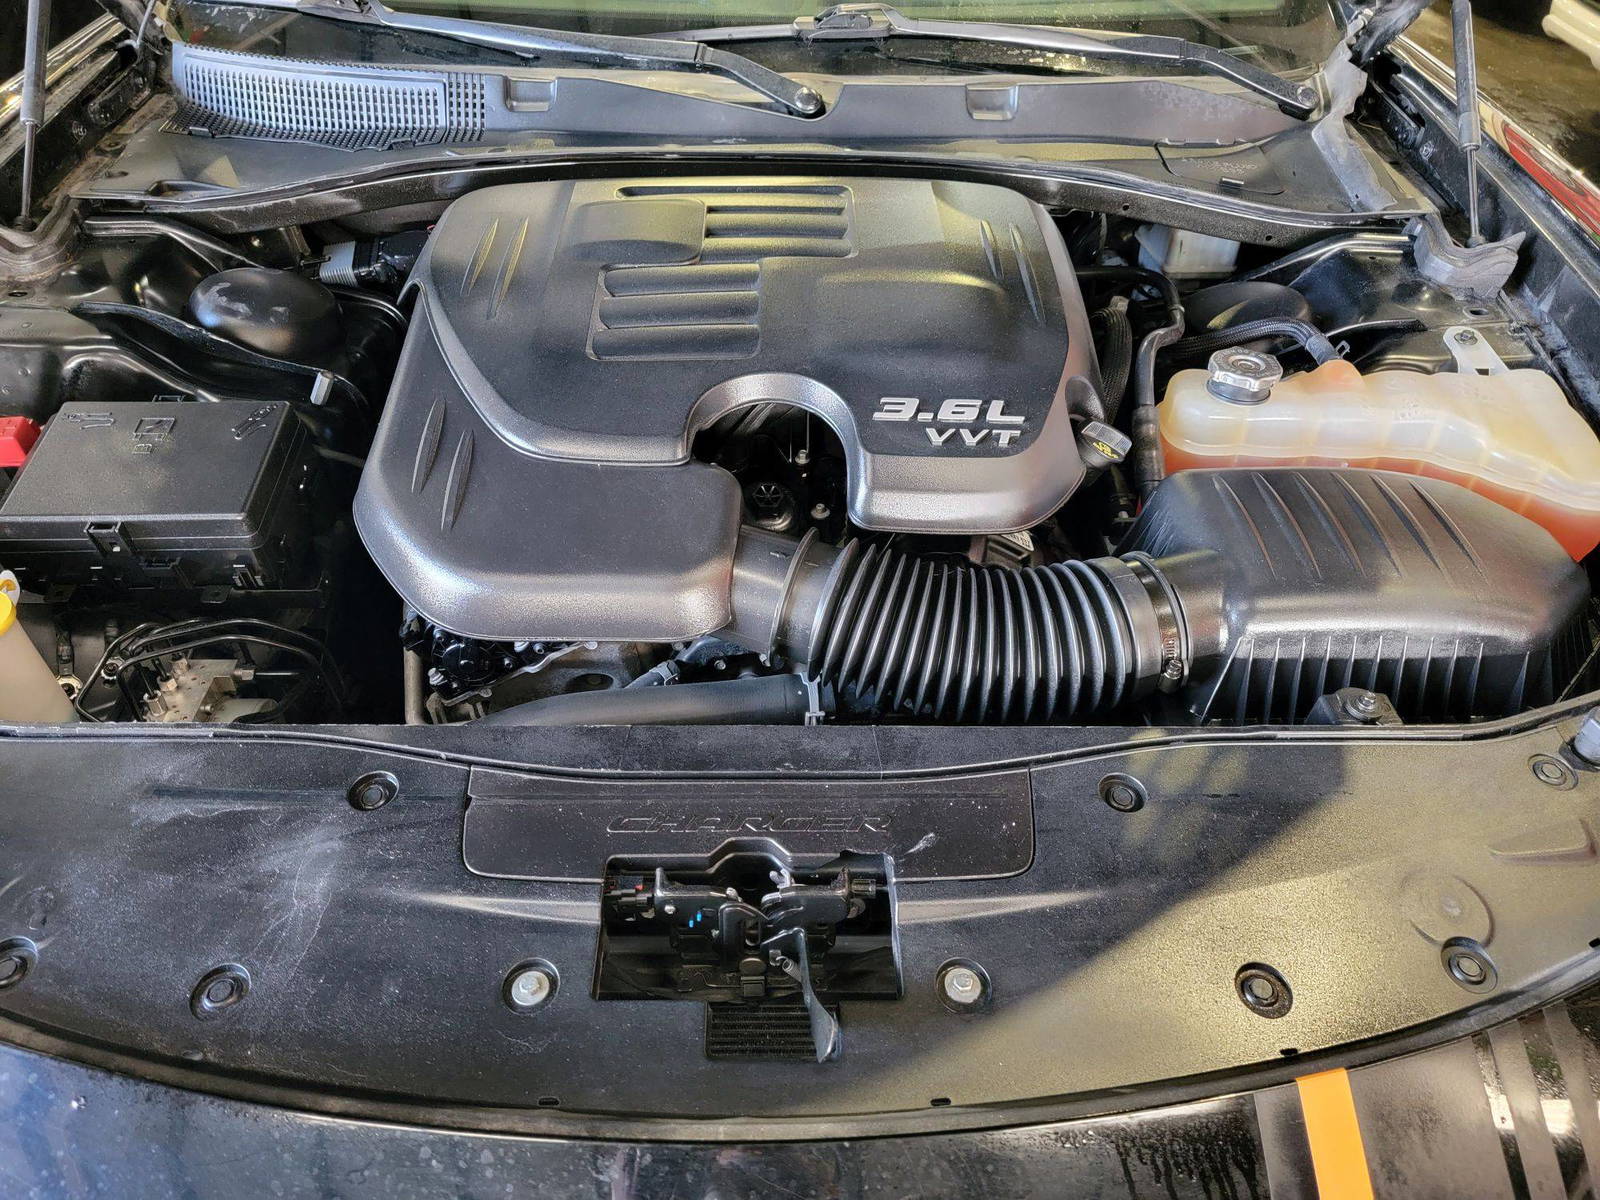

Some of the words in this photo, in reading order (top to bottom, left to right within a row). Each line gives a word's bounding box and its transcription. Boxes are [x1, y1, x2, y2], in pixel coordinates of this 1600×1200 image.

[872, 397, 1026, 424] 3.6L
[925, 427, 1022, 447] VVT
[606, 814, 892, 833] CHARGER
